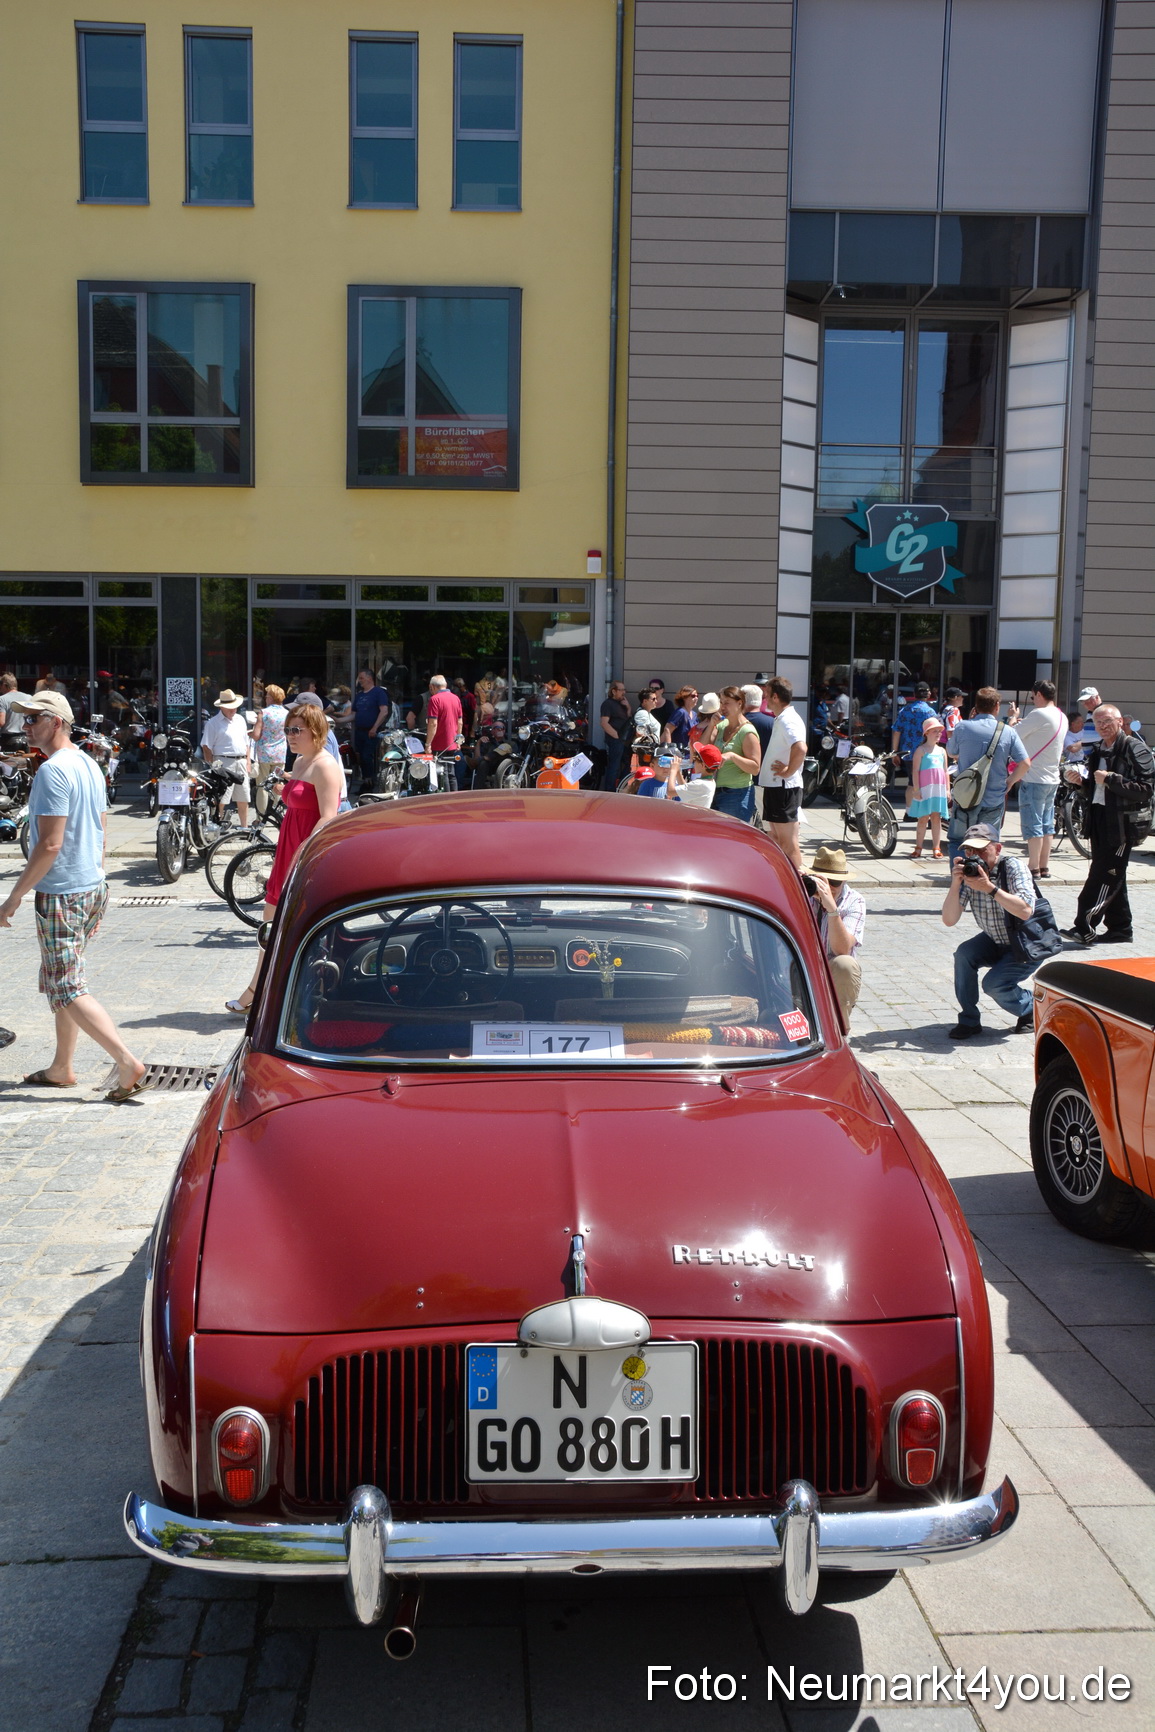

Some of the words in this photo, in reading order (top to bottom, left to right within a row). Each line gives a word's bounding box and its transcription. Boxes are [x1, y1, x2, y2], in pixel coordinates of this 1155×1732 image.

[424, 427, 485, 436] Büroflächen
[886, 523, 928, 574] G2
[783, 1014, 801, 1026] 1000
[542, 1036, 590, 1053] 177
[553, 1355, 587, 1409] N
[477, 1386, 489, 1402] D
[477, 1417, 541, 1473] GO
